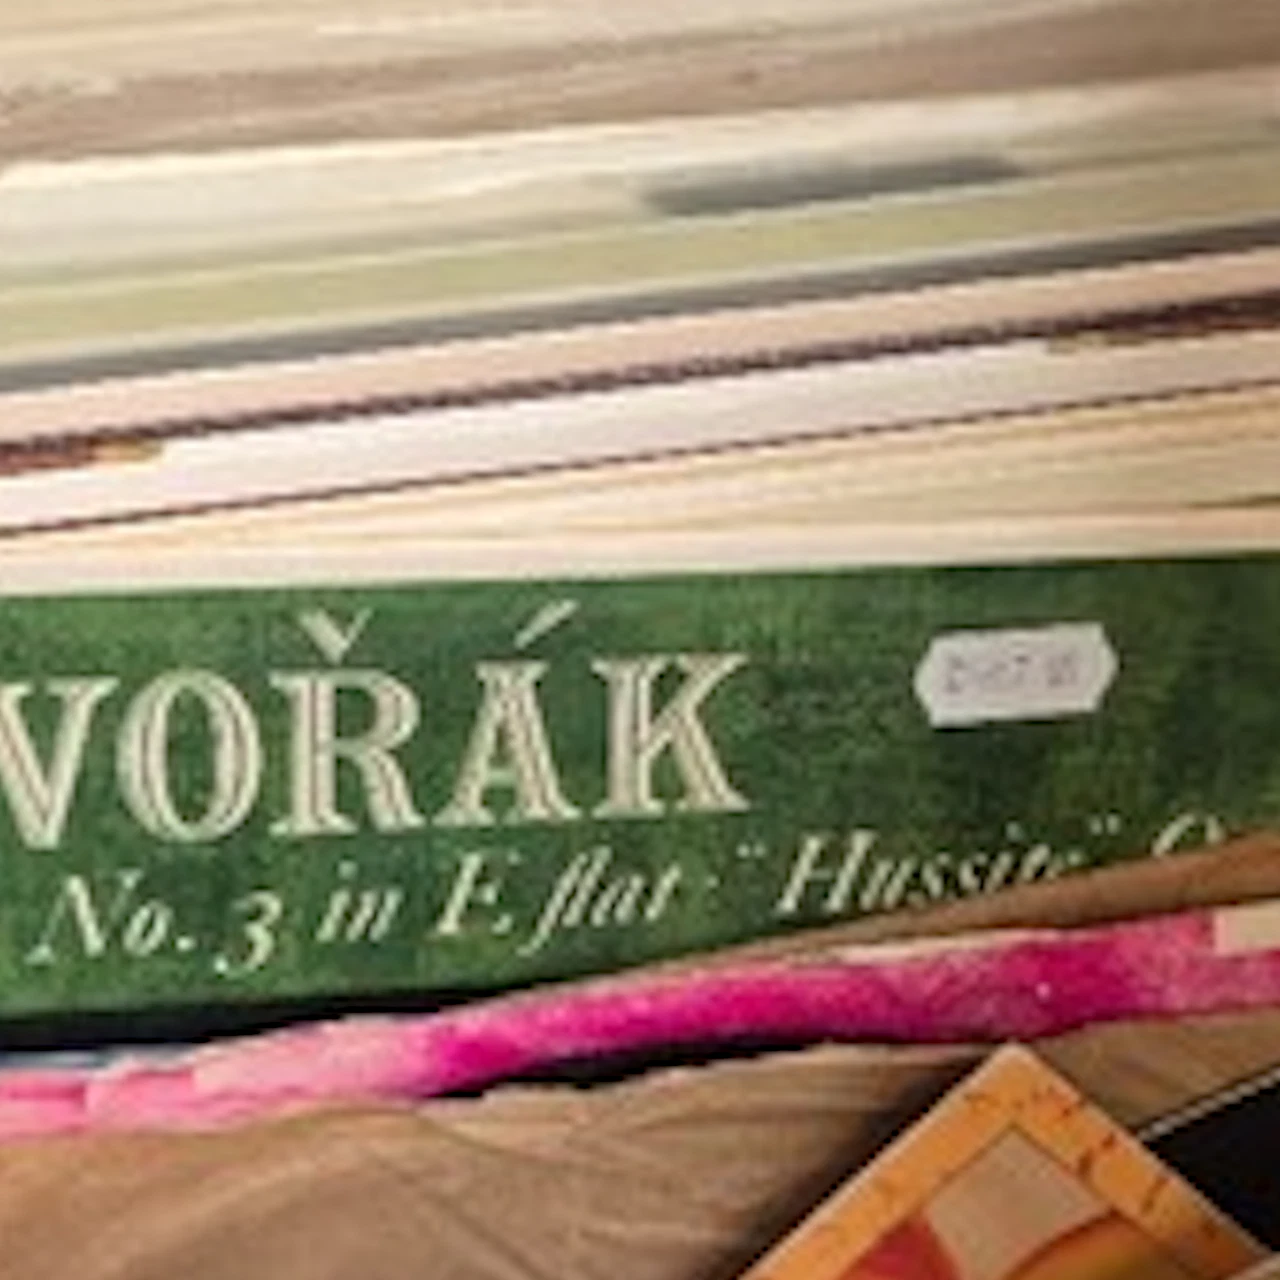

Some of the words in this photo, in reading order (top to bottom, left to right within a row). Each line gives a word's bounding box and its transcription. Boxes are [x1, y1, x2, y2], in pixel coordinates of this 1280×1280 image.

[25, 868, 195, 966] No.
[214, 890, 283, 977] 3
[317, 859, 404, 943] in
[517, 845, 683, 957] flat
